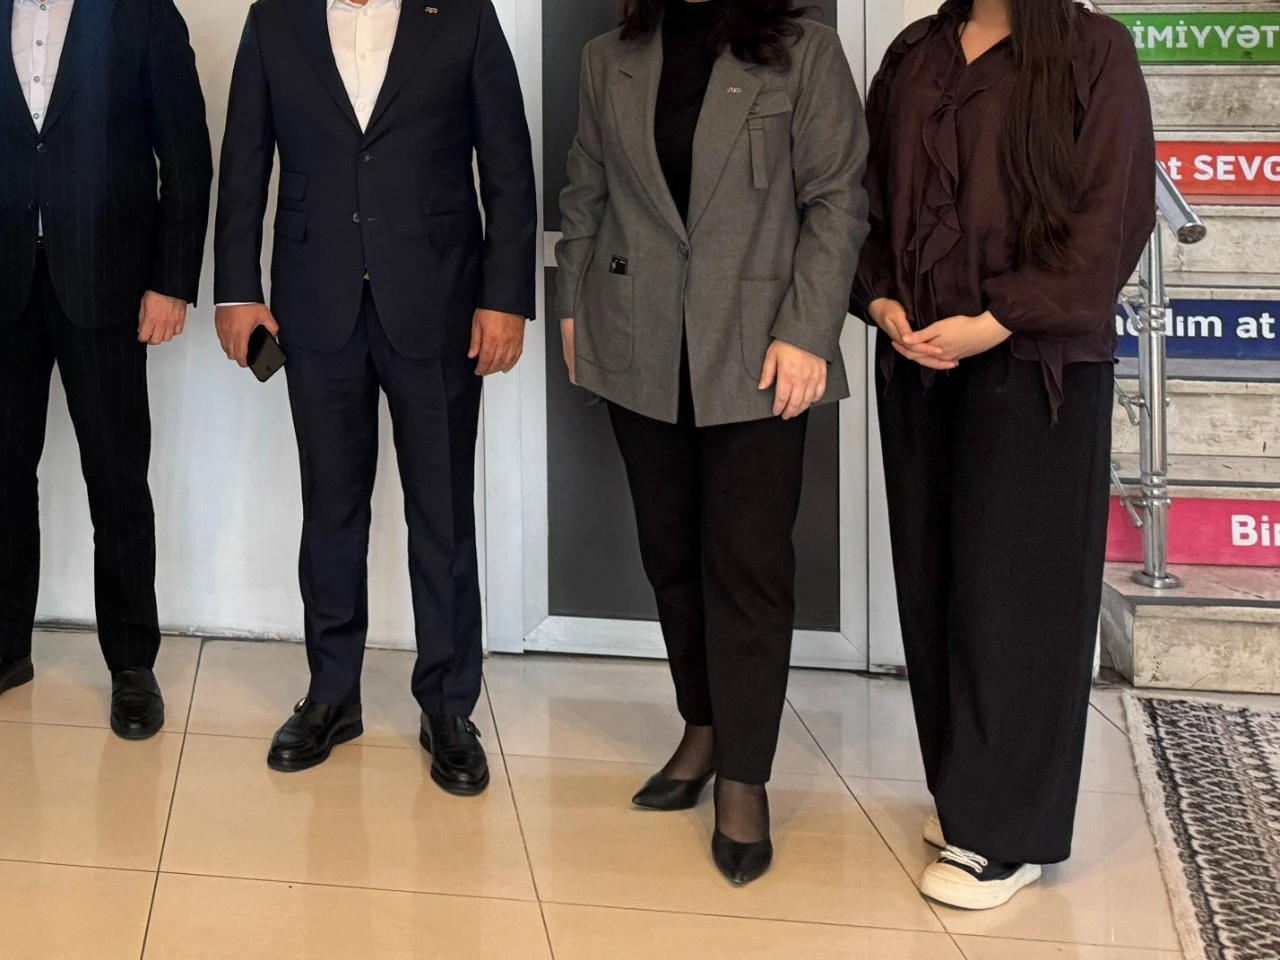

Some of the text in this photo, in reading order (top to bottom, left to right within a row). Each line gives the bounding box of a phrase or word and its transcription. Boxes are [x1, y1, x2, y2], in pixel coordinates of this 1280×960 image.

[1127, 20, 1280, 49] İMİYYƏT
[1160, 156, 1182, 180] t
[1236, 312, 1276, 339] at
